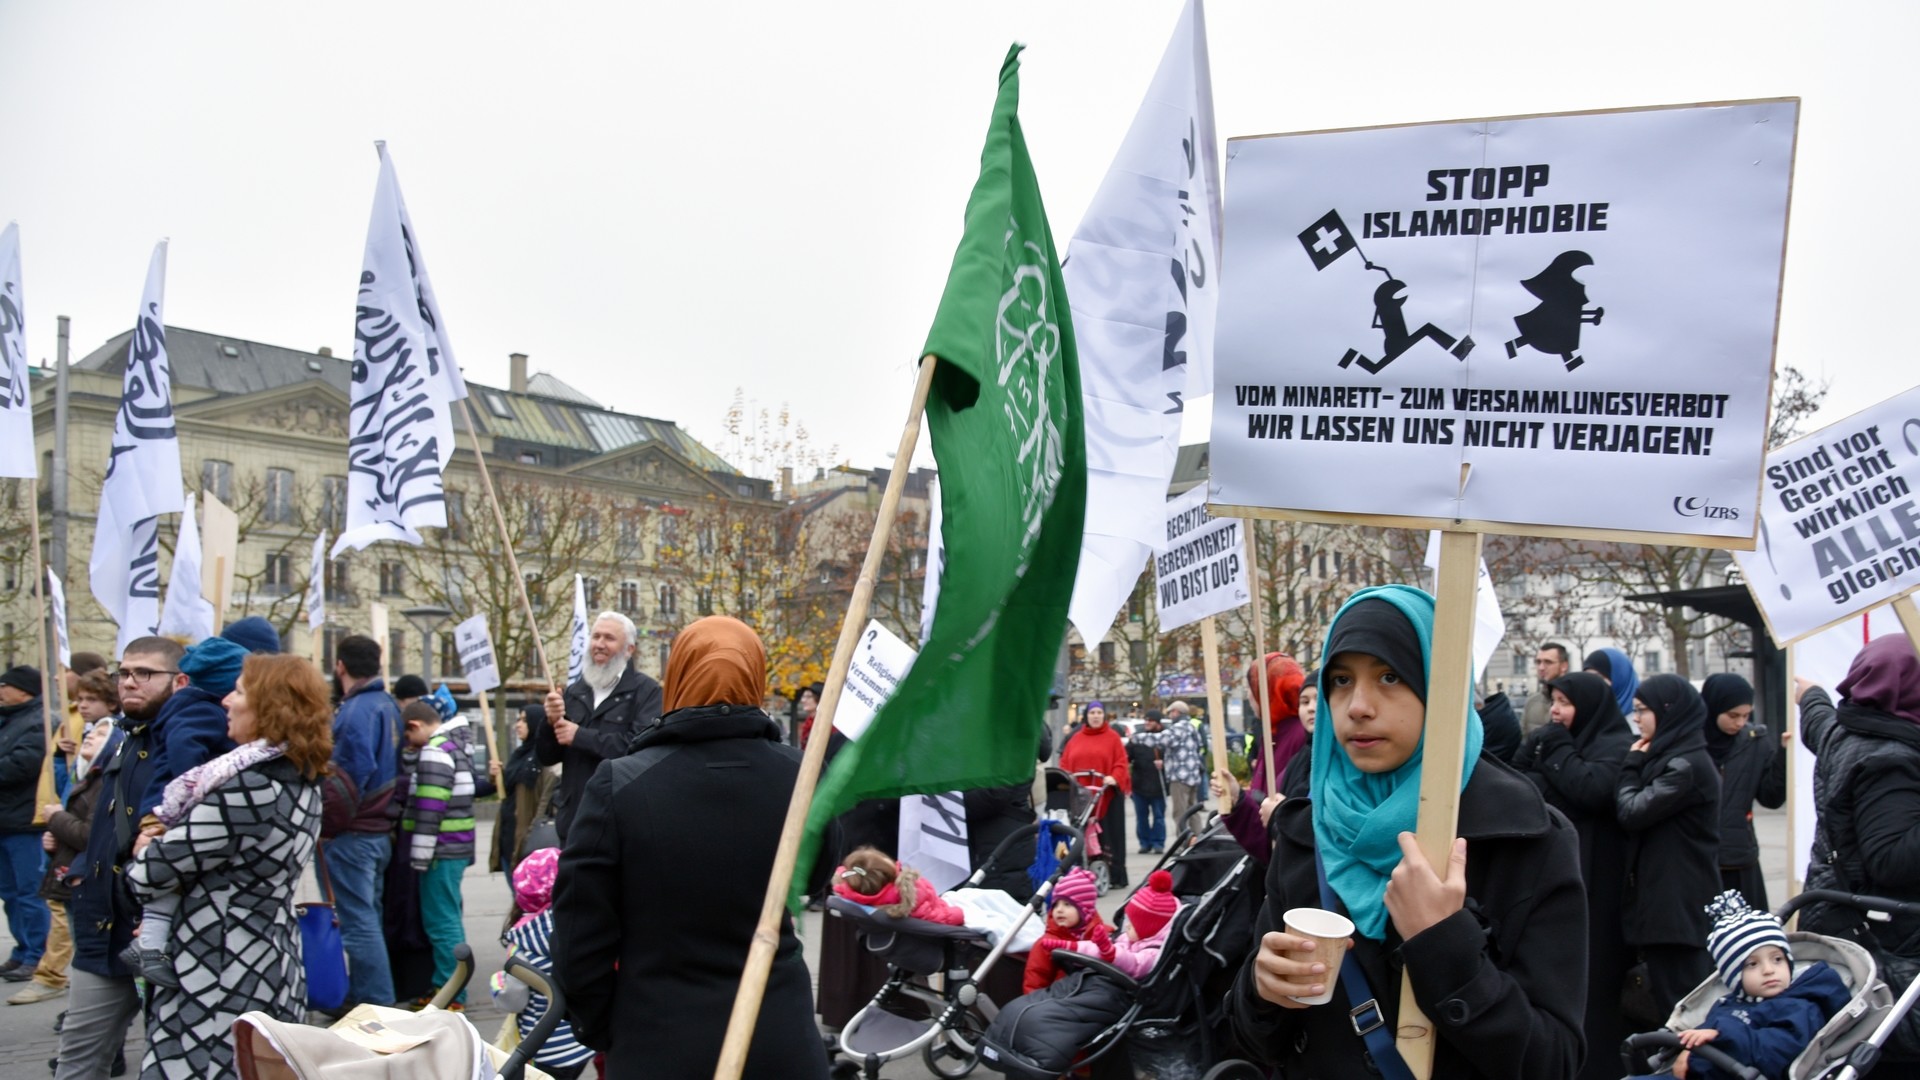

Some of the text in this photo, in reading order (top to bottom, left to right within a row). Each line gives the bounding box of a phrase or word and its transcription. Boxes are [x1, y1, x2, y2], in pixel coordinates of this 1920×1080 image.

[1426, 164, 1549, 201] STOPP
[1363, 203, 1609, 239] ISLAMOPHOBIE
[1235, 385, 1730, 419] VOM MINARETT- ZUM VERSAMMLUNGSVERBOT
[1248, 414, 1714, 456] WIR LASSEN UNS NICHT VERJAGEN!
[1767, 445, 1833, 490] Sind
[1833, 424, 1882, 454] vor
[1779, 448, 1896, 513] Gericht
[1704, 506, 1739, 520] IZRS
[1793, 475, 1910, 539] wirklich
[1157, 523, 1237, 578] GERECHTIGKEIT
[1812, 500, 1920, 579] ALLE
[1160, 553, 1239, 609] WO BIST DU?
[1827, 541, 1920, 605] gleich
[867, 630, 878, 650] ?
[850, 662, 891, 700] Versammlu
